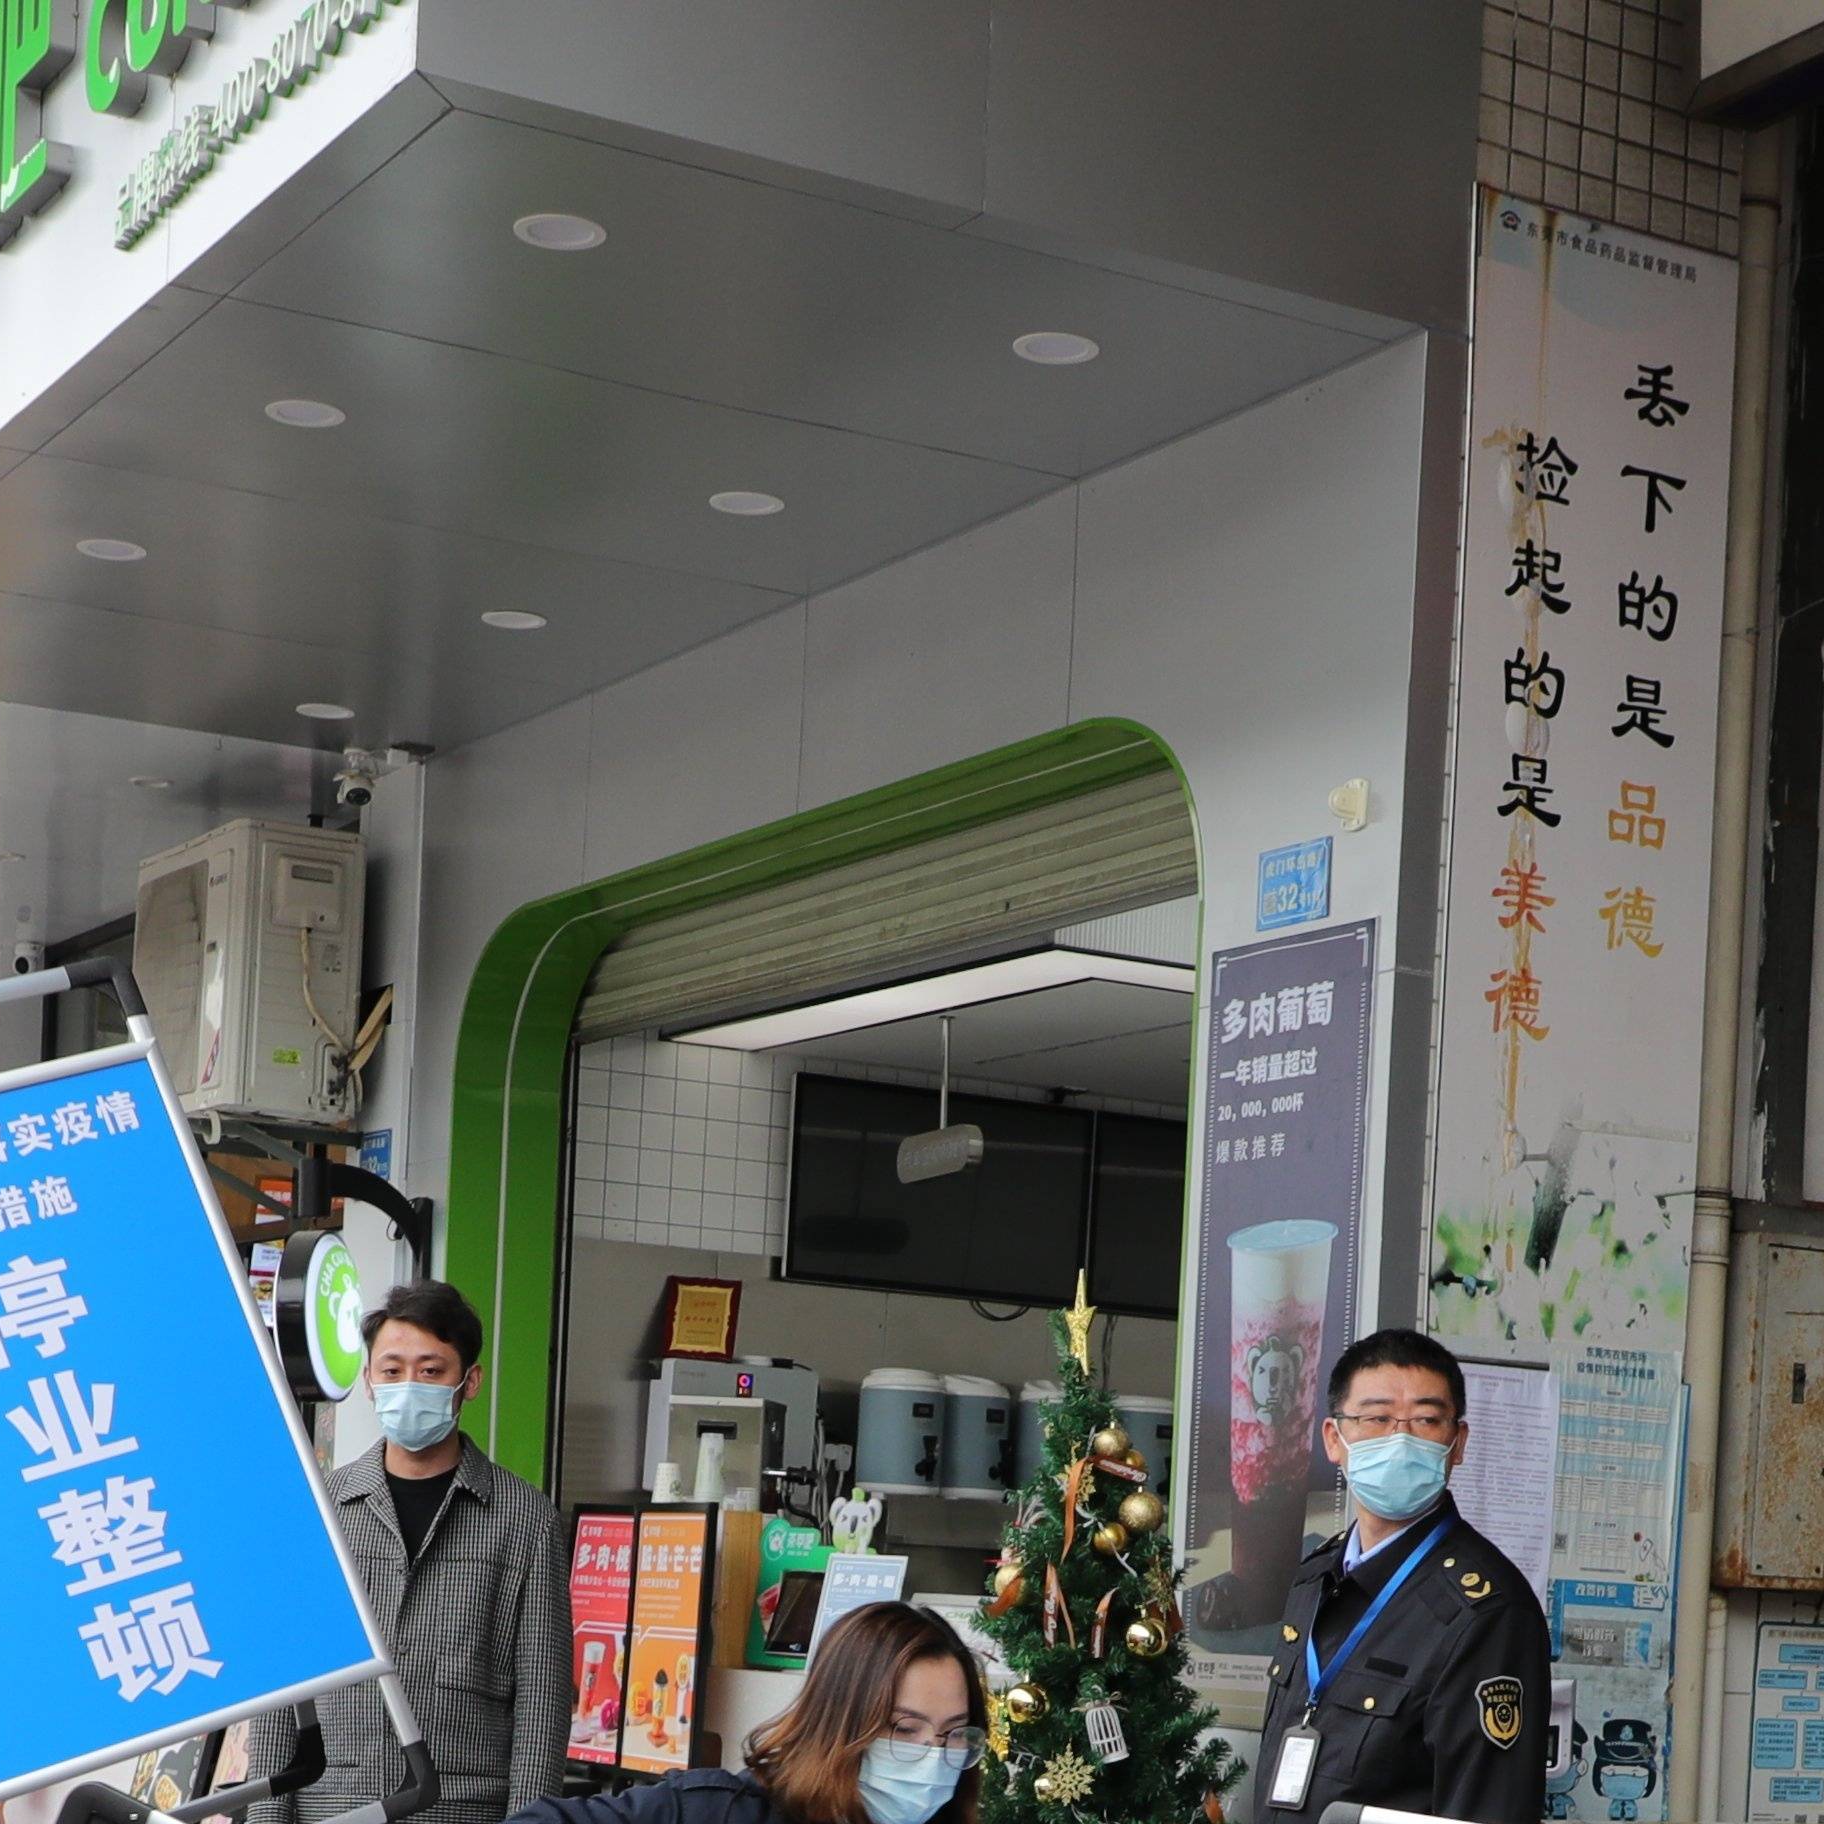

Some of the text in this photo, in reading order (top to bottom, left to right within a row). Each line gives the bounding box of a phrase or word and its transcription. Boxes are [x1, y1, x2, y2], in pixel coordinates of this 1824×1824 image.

[1598, 363, 1691, 958] 丢下的是品德
[1483, 432, 1579, 1043] 捡起的是美德
[1220, 979, 1336, 1045] 多肉葡萄
[1219, 1046, 1319, 1088] 一年销量超过
[1215, 1131, 1287, 1166] 爆款推荐
